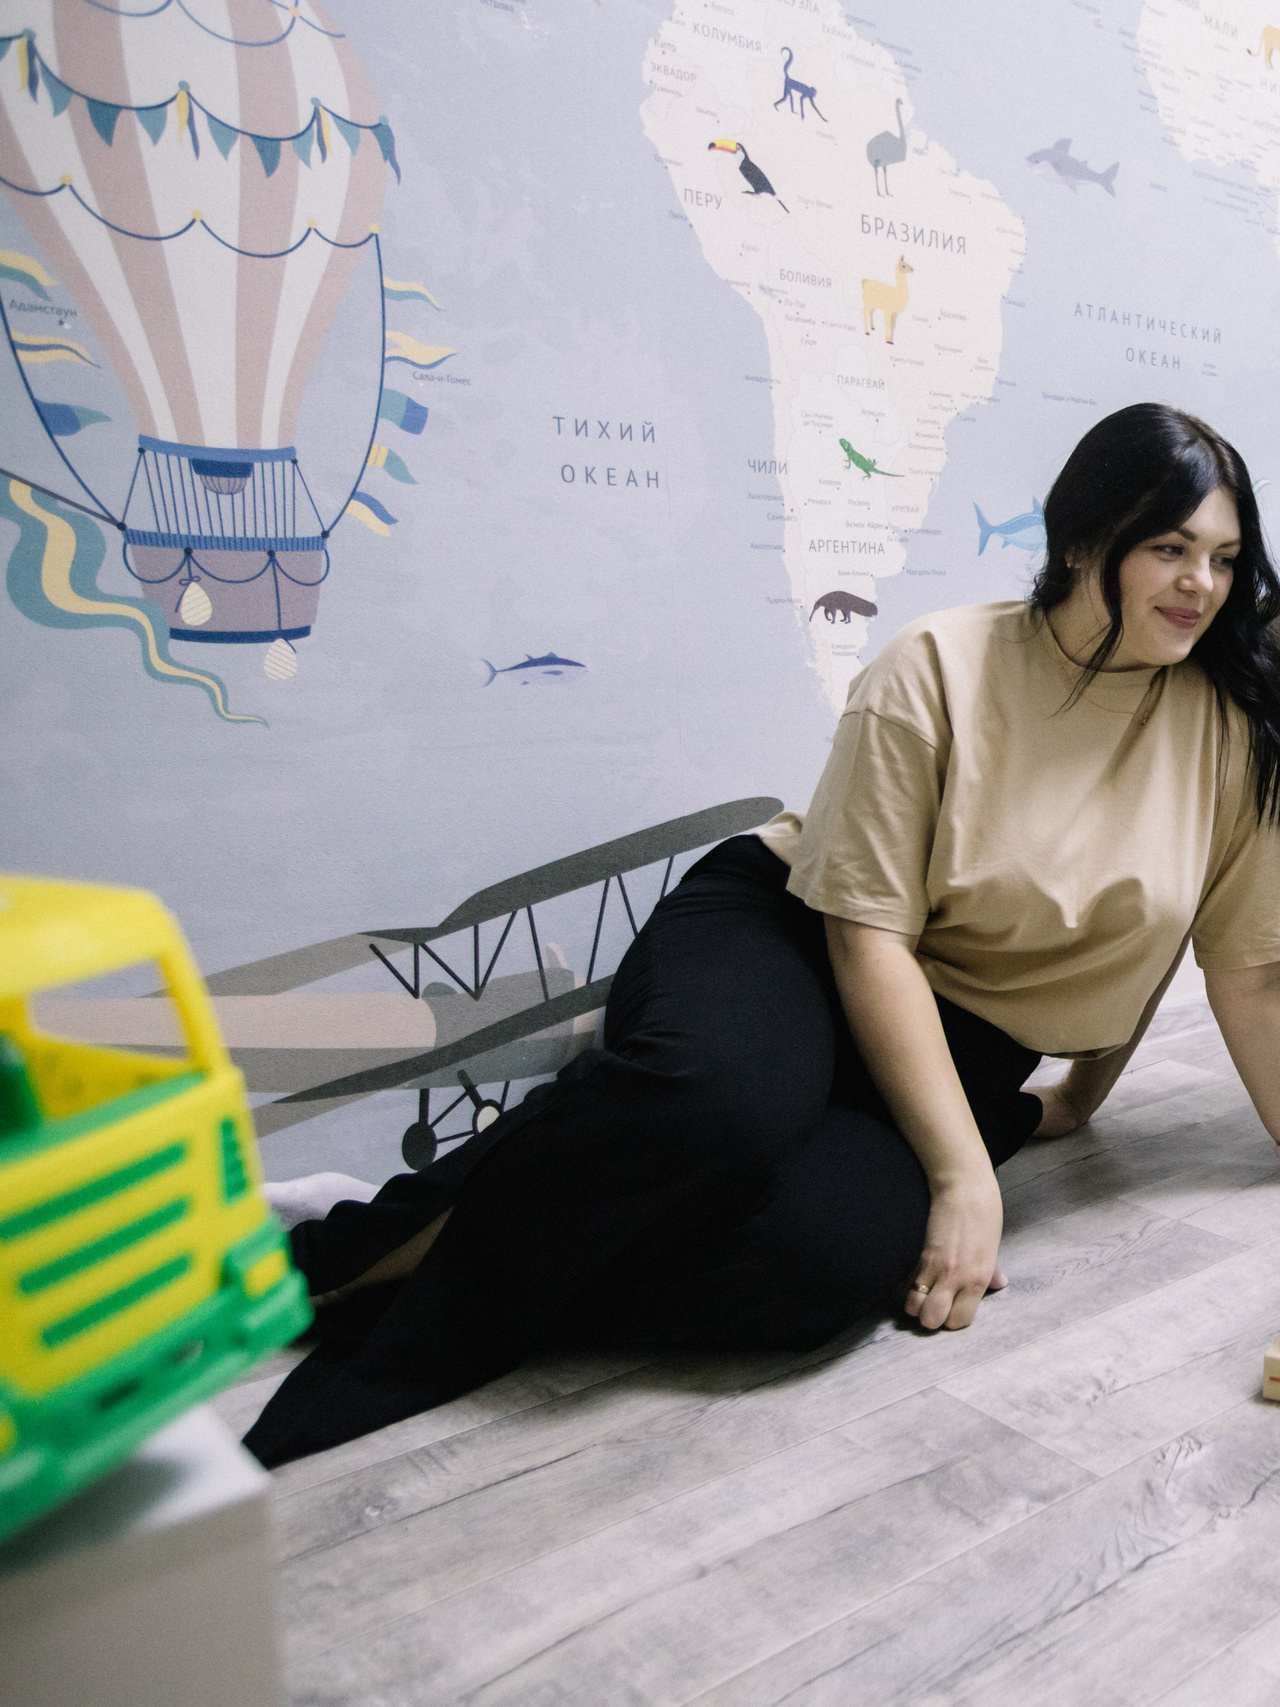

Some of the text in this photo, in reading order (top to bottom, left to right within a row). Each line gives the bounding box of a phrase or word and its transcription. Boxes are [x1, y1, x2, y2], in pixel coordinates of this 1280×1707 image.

[692, 22, 763, 53] КОЛУМБИЯ
[649, 61, 697, 82] ЭКВАДОР
[683, 188, 723, 210] ПЕРУ
[860, 213, 967, 255] БРАЗИЛИЯ
[779, 268, 833, 289] БОЛИВИЯ
[8, 298, 78, 319] Адамстаун
[1073, 300, 1223, 345] АТЛАНТИЧЕСКИЙ
[1124, 346, 1182, 371] ОКЕАН
[412, 370, 472, 387] Сала-и-Гомес
[836, 372, 886, 392] ПАРАГВАЙ
[552, 415, 657, 444] ТИХИЙ
[560, 463, 661, 490] ОКЕАН
[747, 458, 789, 476] ЧИЛИ
[808, 538, 886, 556] АРГЕНТИНА
